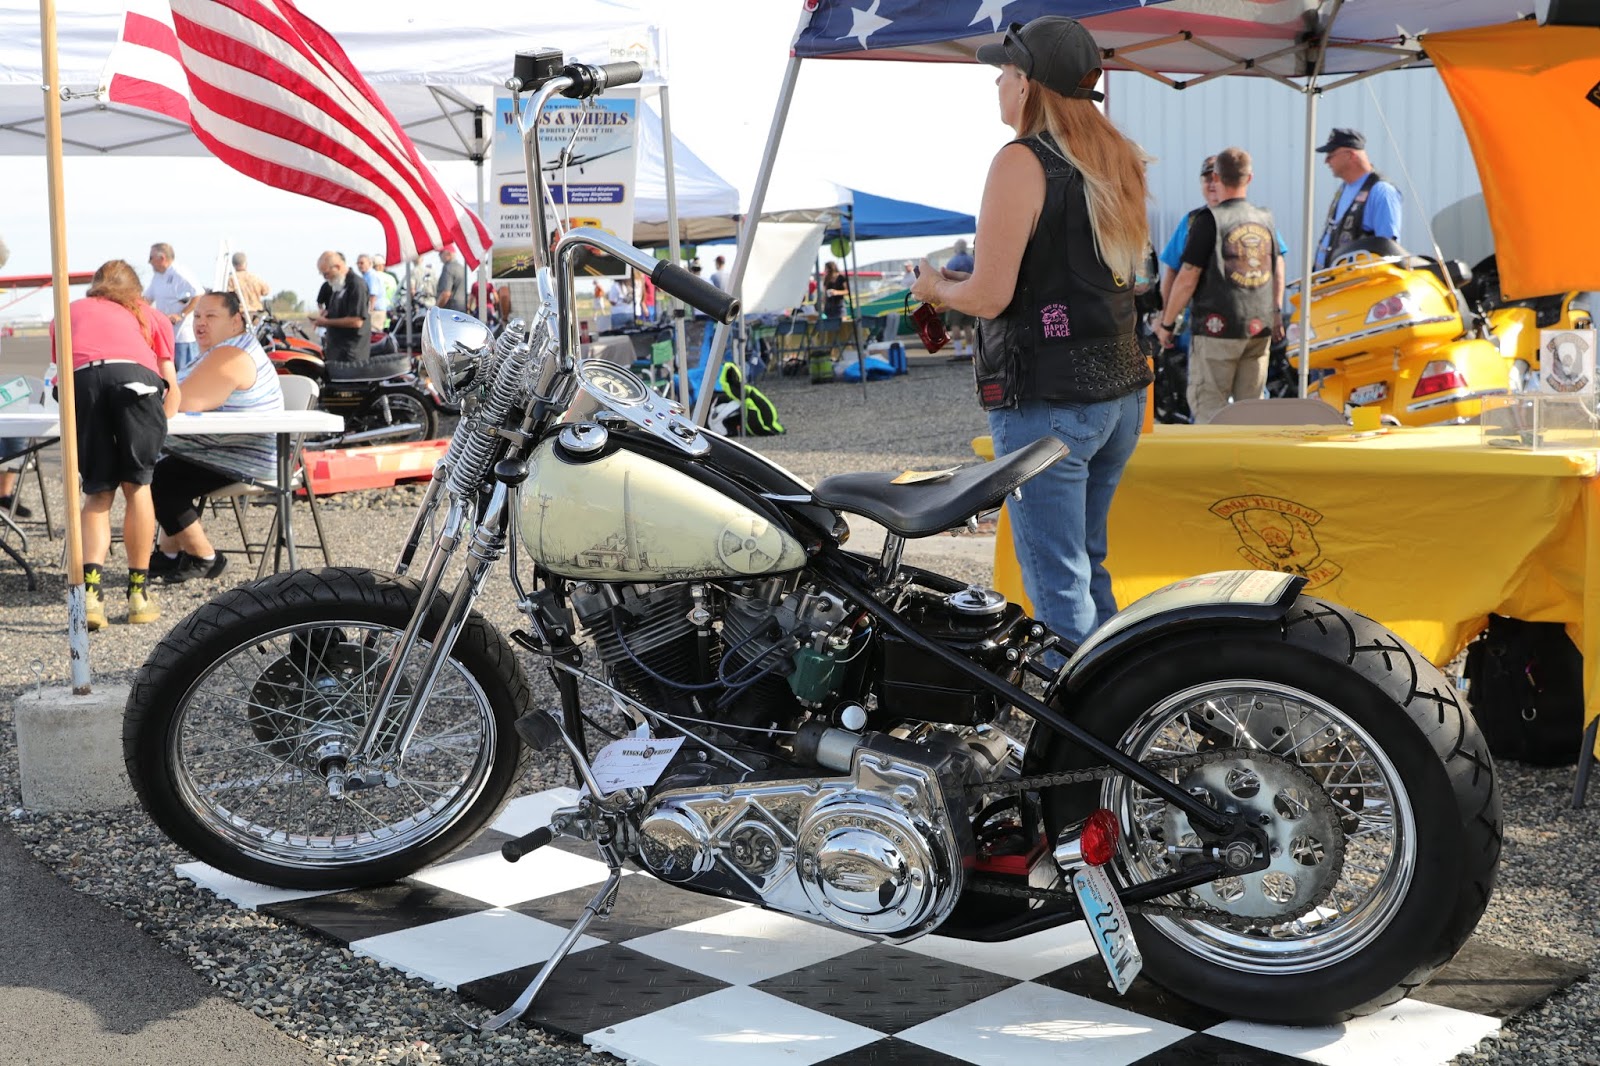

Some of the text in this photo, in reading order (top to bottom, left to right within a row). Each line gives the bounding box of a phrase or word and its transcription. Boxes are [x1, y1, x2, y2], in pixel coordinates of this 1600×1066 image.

[570, 112, 629, 125] WHEELS
[1040, 304, 1052, 314] THIS
[1043, 323, 1069, 332] HAPPY
[1044, 329, 1071, 339] PLACE
[675, 569, 724, 580] REACTOR
[1085, 877, 1098, 901] VEHICLE
[1087, 870, 1103, 903] COLLECTOR
[1097, 867, 1127, 928] WASHINGTON
